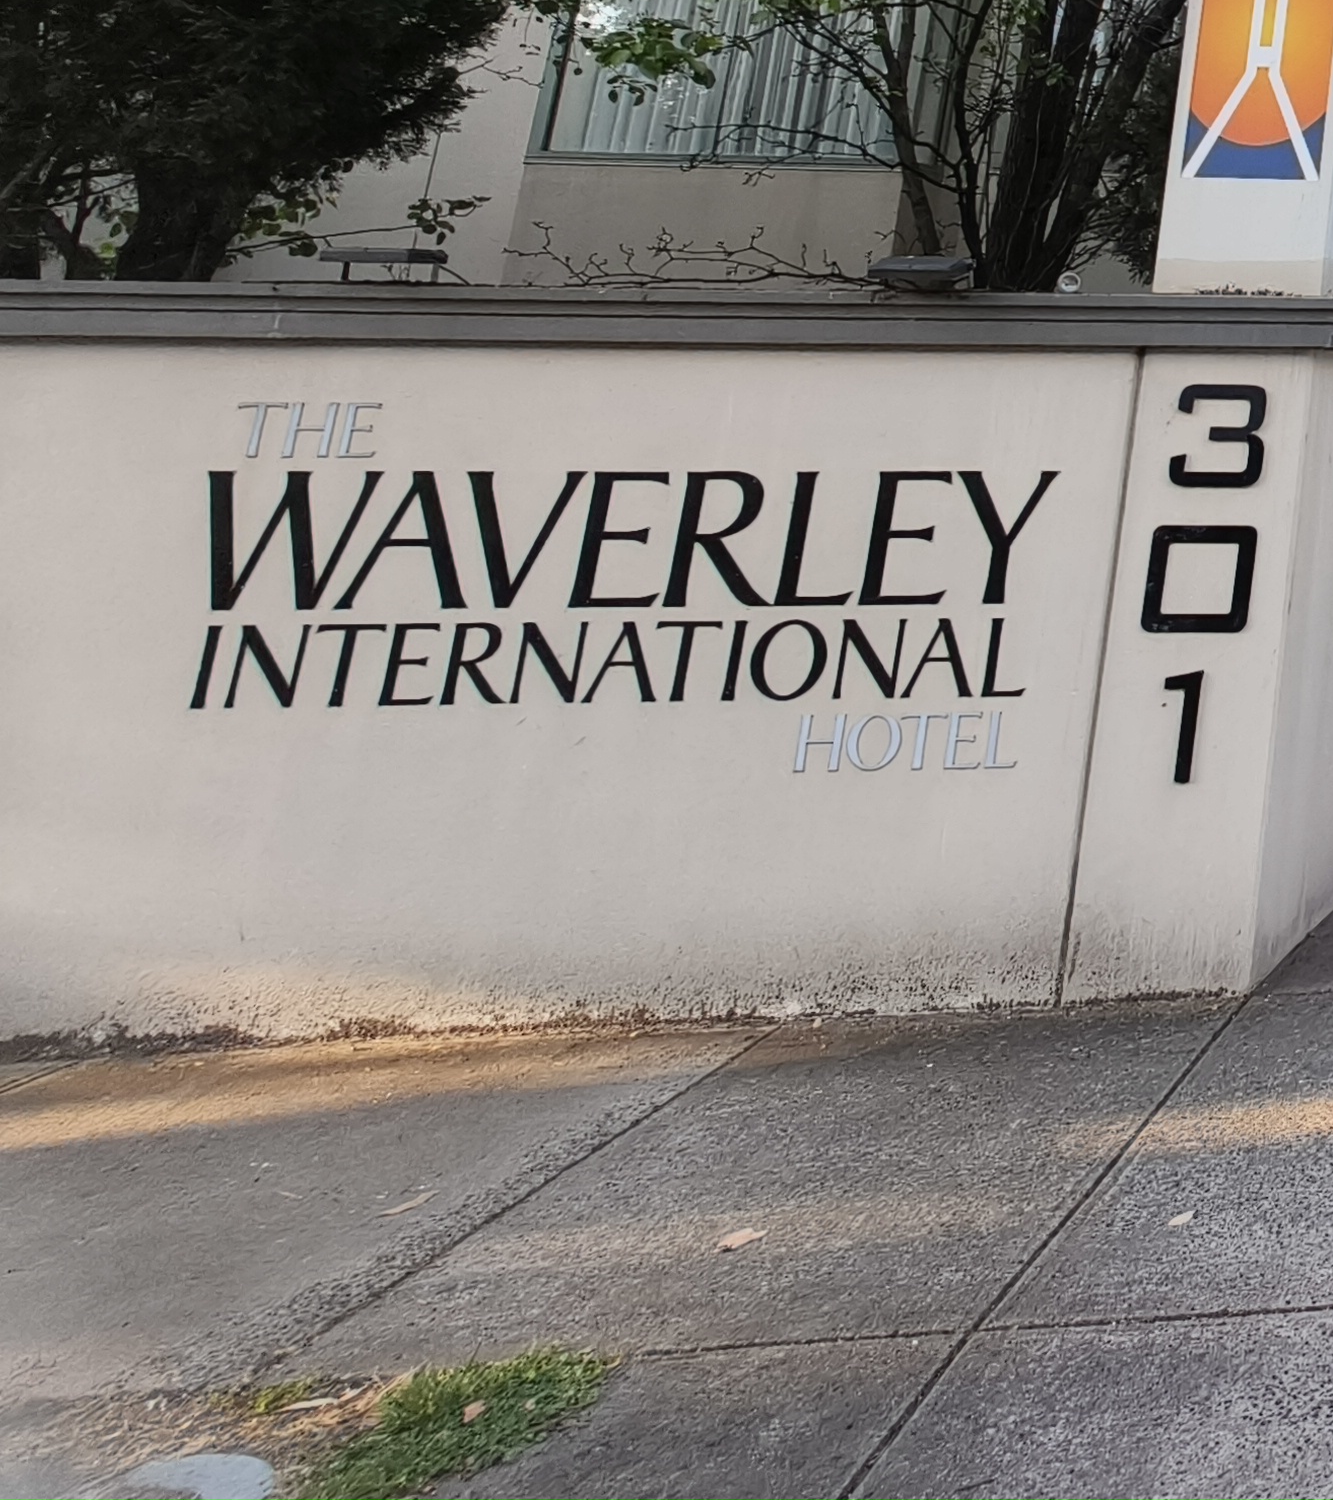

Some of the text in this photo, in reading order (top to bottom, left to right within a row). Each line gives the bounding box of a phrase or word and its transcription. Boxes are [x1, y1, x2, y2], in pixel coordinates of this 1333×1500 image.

[237, 401, 384, 458] THE
[207, 469, 1060, 611] WAVERLEY
[188, 617, 1026, 710] INTERNATIONAL
[793, 710, 1018, 773] HOTEL
